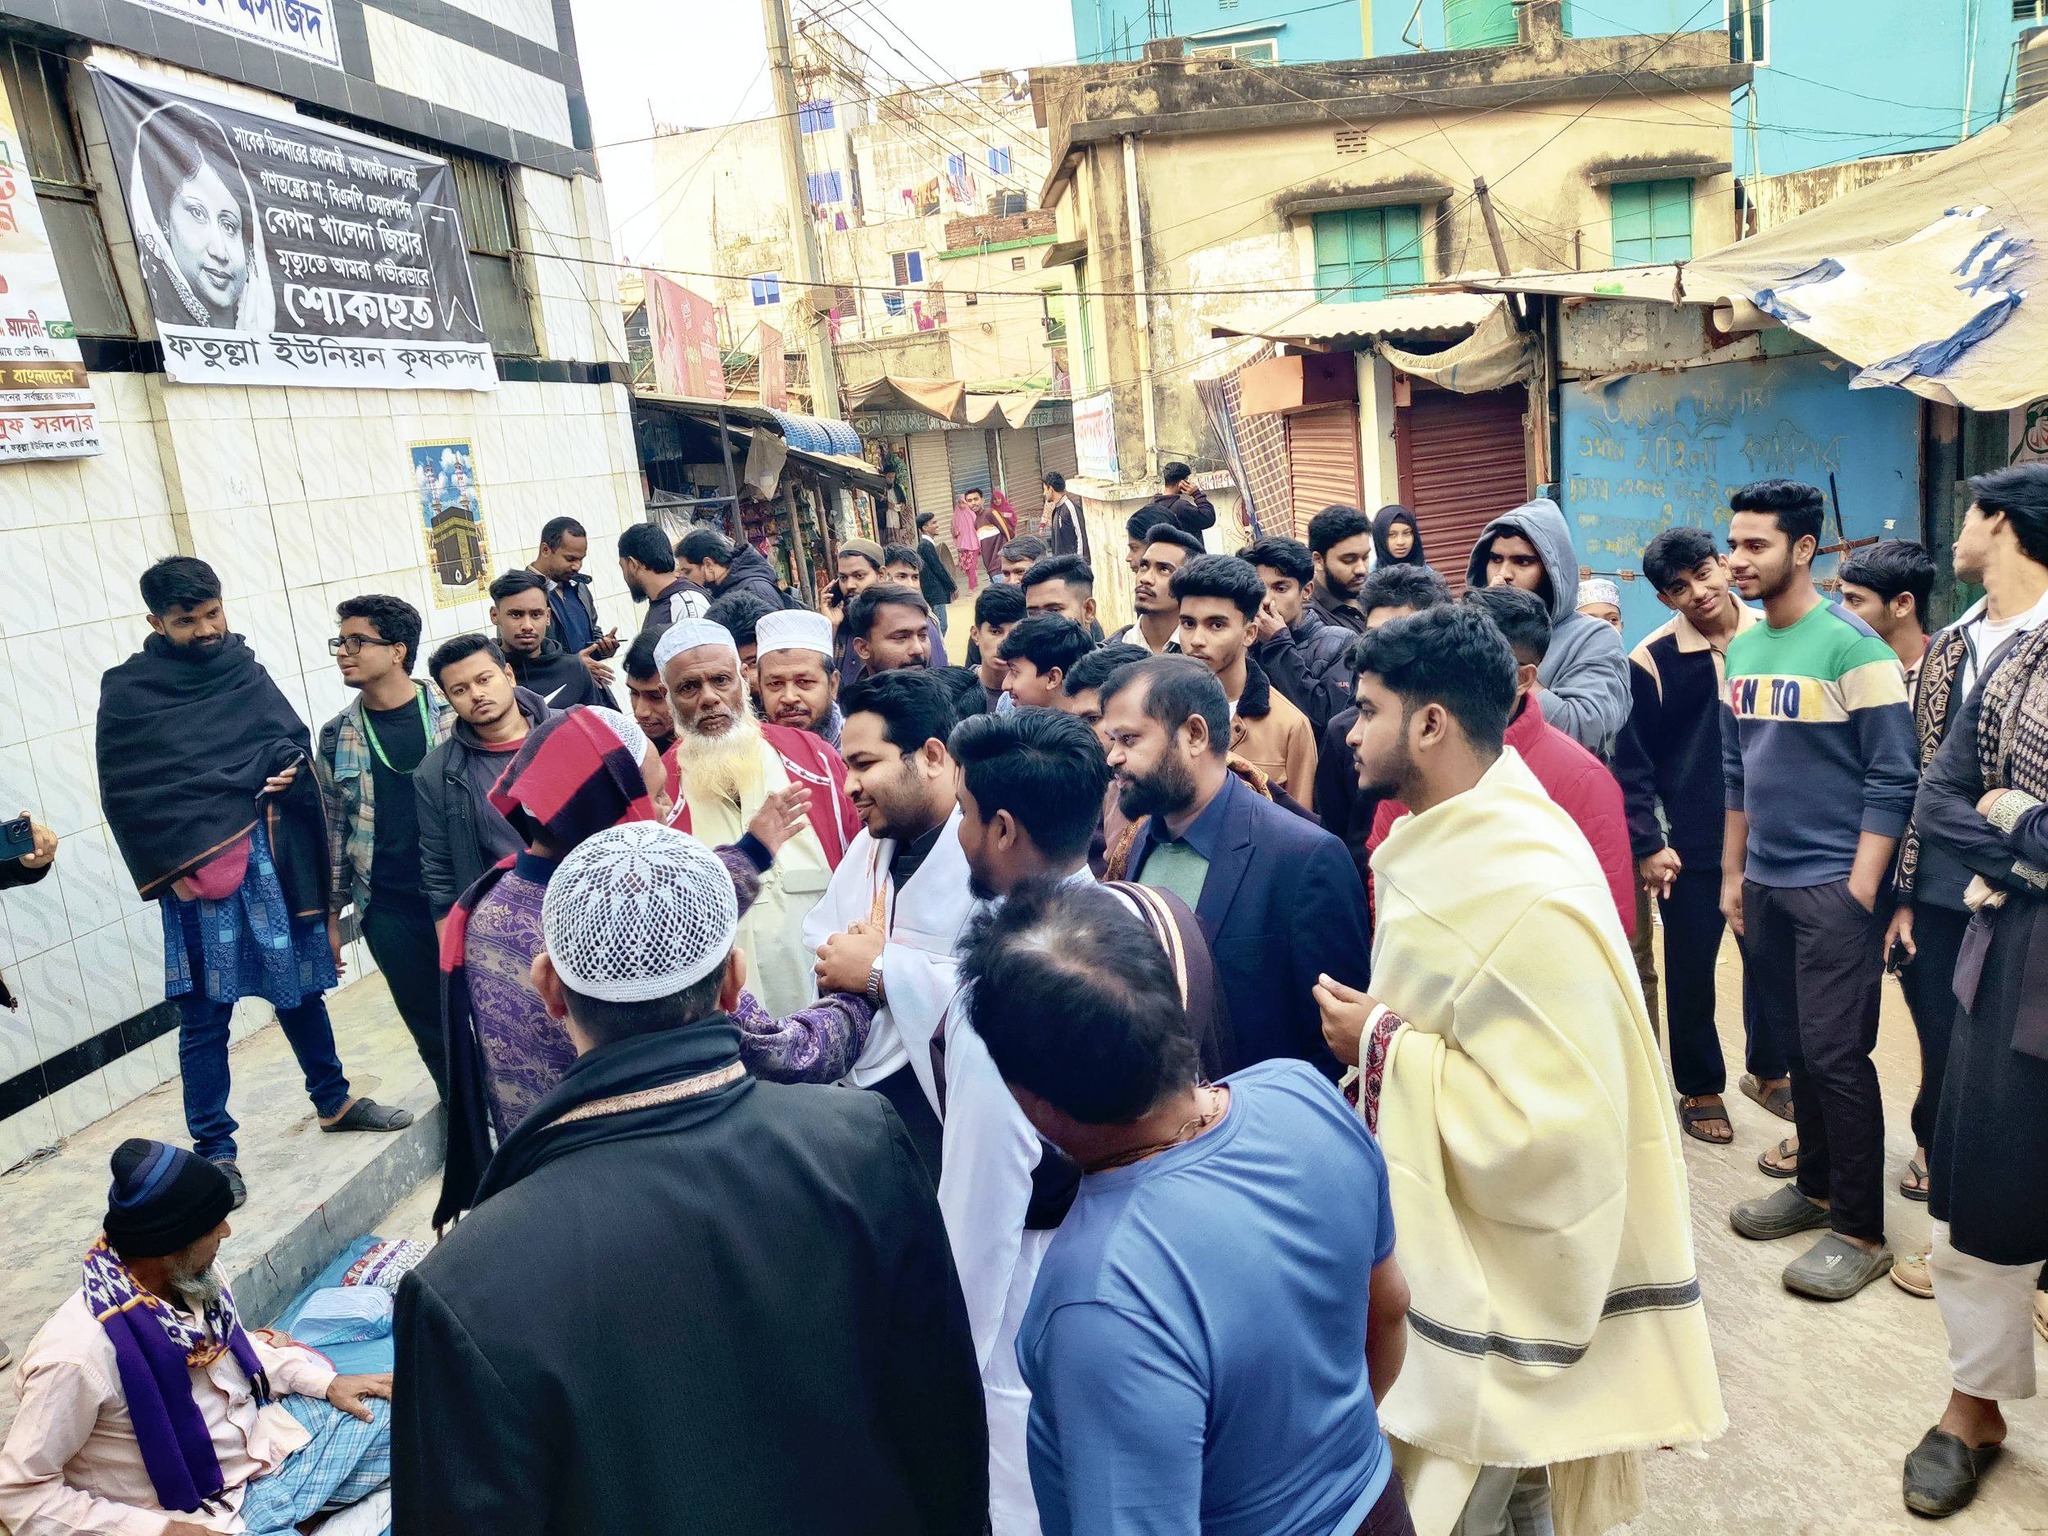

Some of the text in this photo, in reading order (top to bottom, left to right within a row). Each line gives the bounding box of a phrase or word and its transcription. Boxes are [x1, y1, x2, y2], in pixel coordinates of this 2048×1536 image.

[231, 126, 264, 155] সাবেক
[264, 128, 309, 166] তিনবারের
[260, 169, 309, 201] গণতন্ত্রের
[308, 180, 328, 209] মা,
[326, 178, 365, 212] বিএনপি
[265, 206, 423, 257] বেগম খালেদা জিয়ার
[275, 249, 430, 286] মৃত্যুতে আমরা গভীরভাবে
[283, 283, 433, 331] শোকাহত
[14, 346, 31, 357] ভোট
[164, 333, 488, 379] ফতুল্লা ইউনিয়ন কৃষকদল
[12, 369, 74, 386] বাংলাদেশ
[30, 413, 94, 434] সরদার
